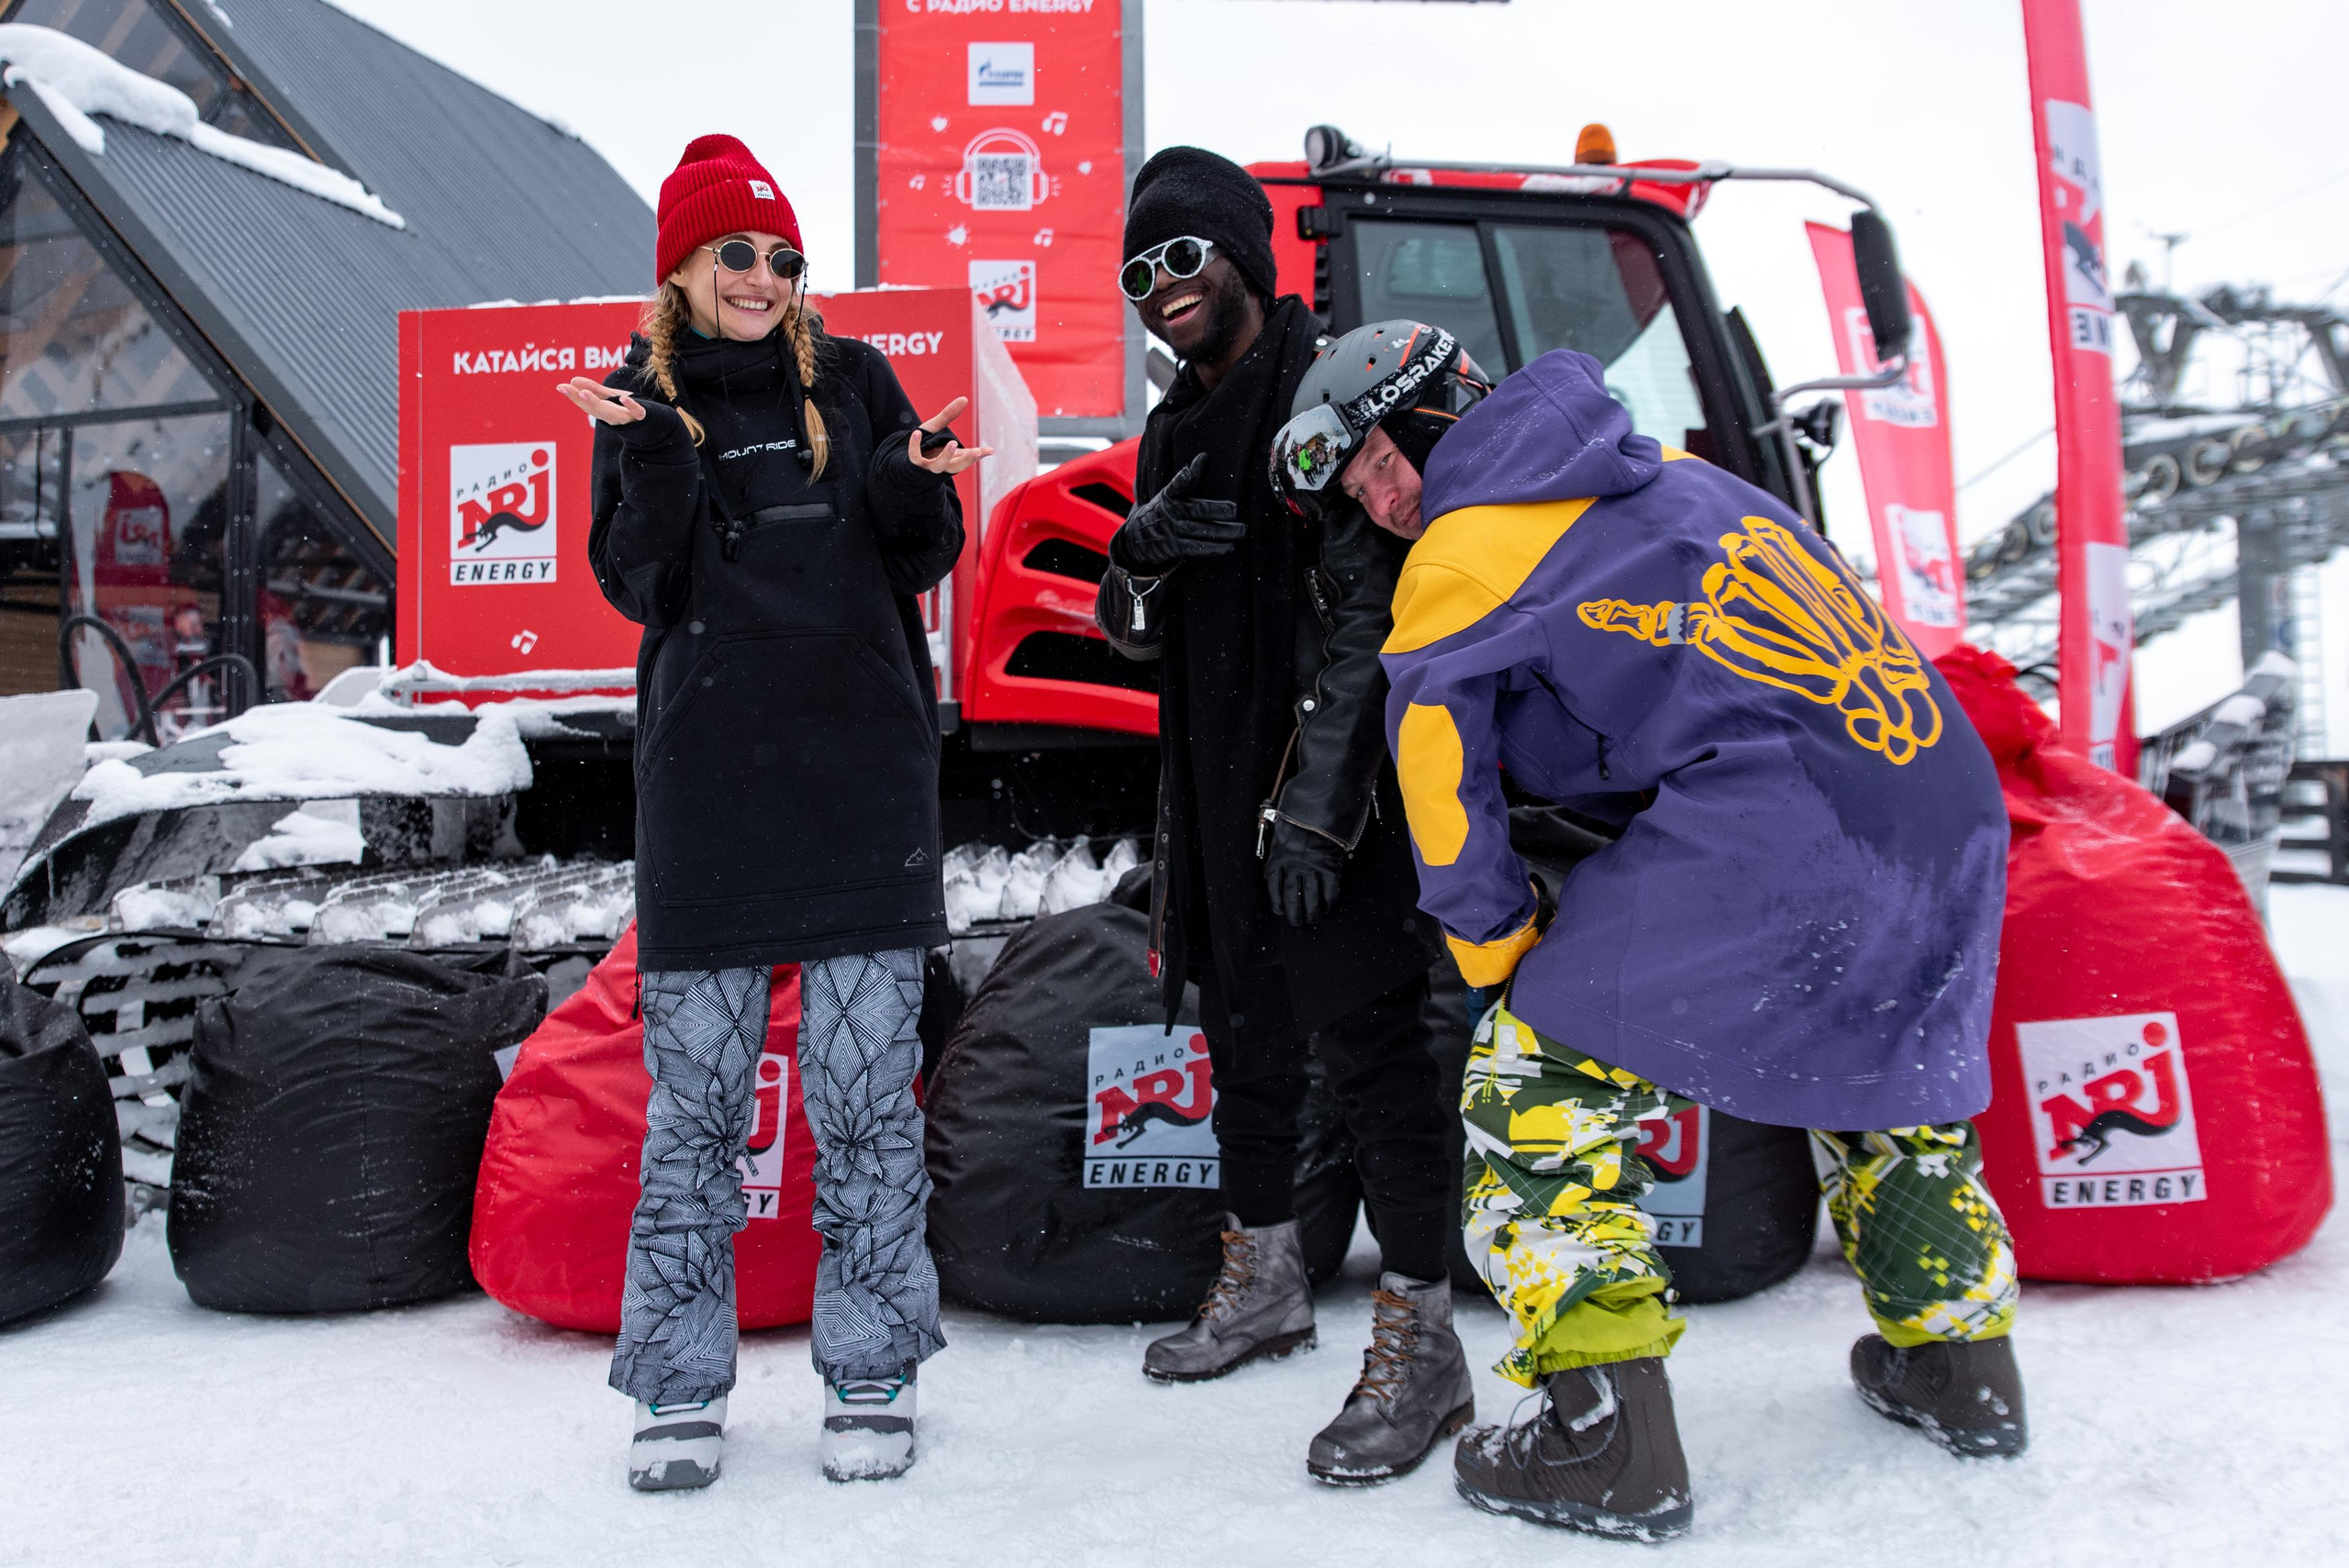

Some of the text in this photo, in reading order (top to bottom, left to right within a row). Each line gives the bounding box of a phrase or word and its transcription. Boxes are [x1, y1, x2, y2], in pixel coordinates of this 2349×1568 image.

[453, 342, 575, 374] КАТАЙСЯ
[718, 439, 797, 461] MOUNT RIDE
[457, 462, 528, 497] РАДИО
[457, 449, 550, 550] NRJ
[455, 562, 551, 582] ENERGY
[1095, 1047, 1185, 1086] РАДИО
[2037, 1042, 2140, 1094] РАДИО
[1093, 1033, 1213, 1148] NRJ
[2040, 1021, 2181, 1163] NRJ
[1089, 1162, 1213, 1184] ENERGY
[2054, 1174, 2198, 1205] ENERGY
